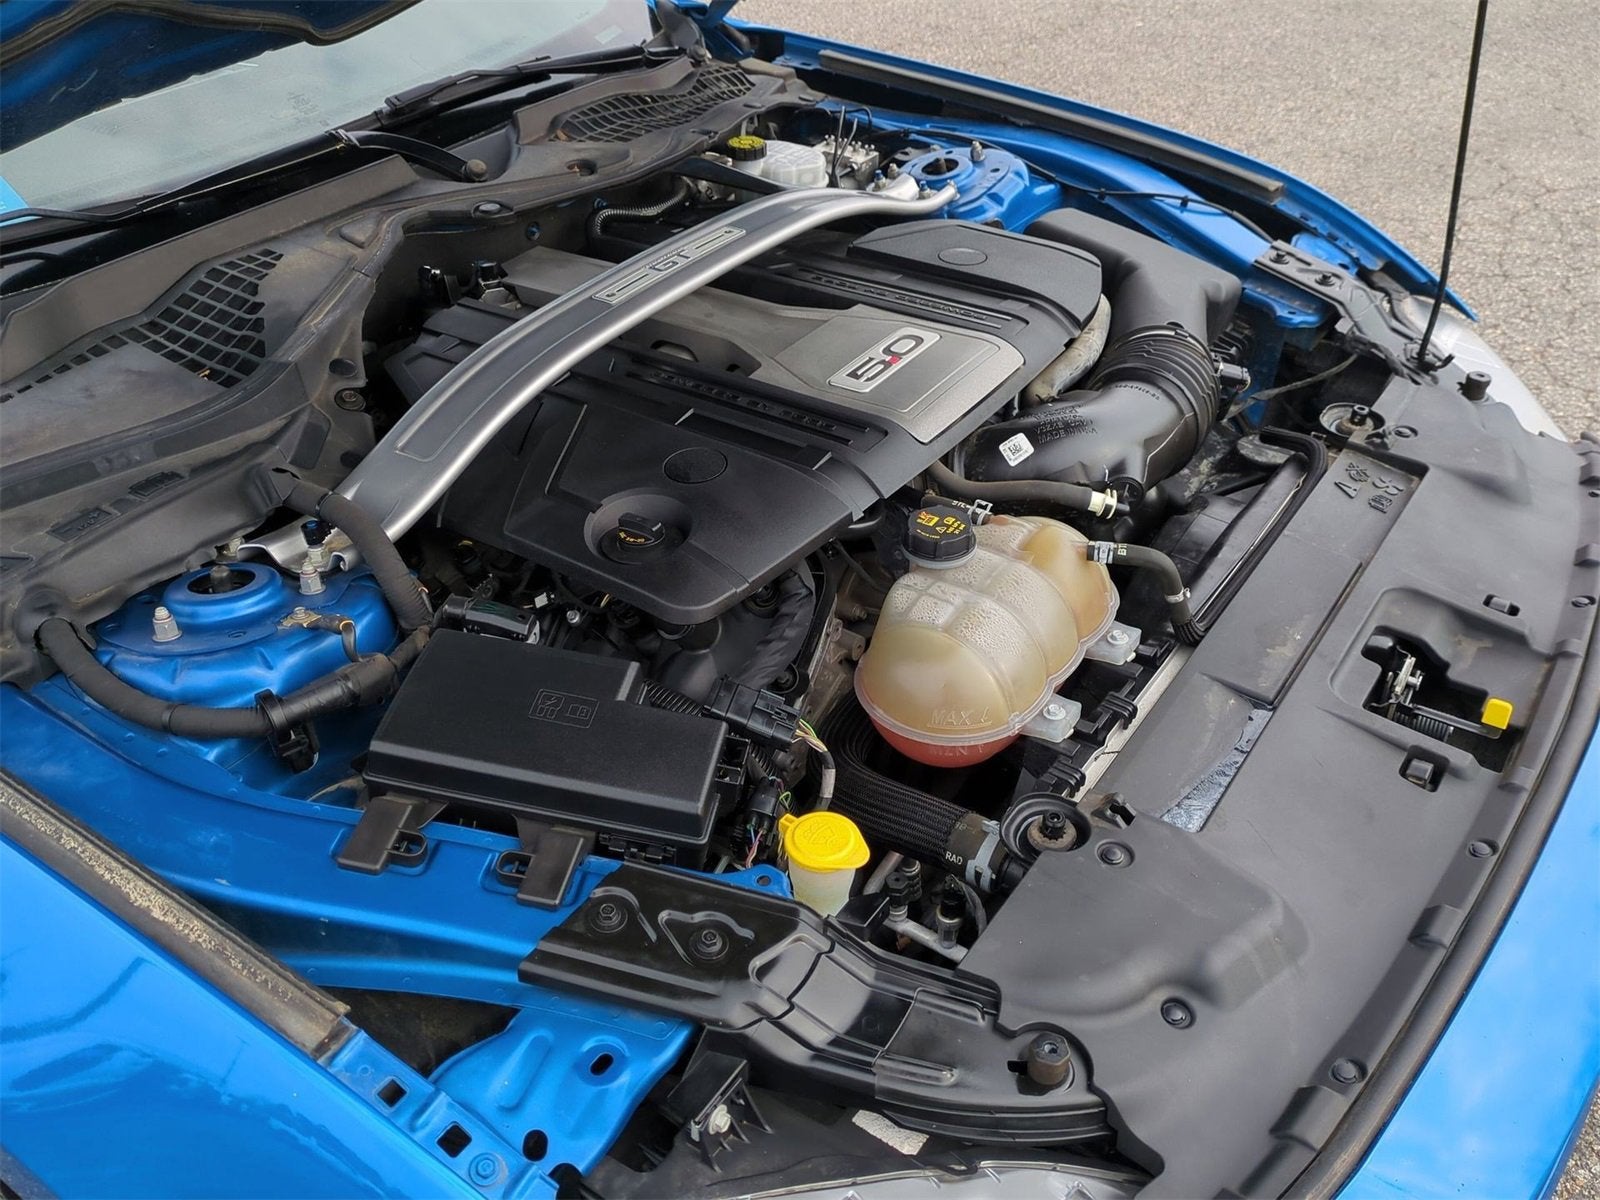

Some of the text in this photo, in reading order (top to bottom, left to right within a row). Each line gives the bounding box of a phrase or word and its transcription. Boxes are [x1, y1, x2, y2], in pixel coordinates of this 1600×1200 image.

[647, 248, 692, 273] GT
[845, 334, 925, 383] 5.0
[931, 708, 971, 726] MAX
[945, 850, 963, 865] RAD
